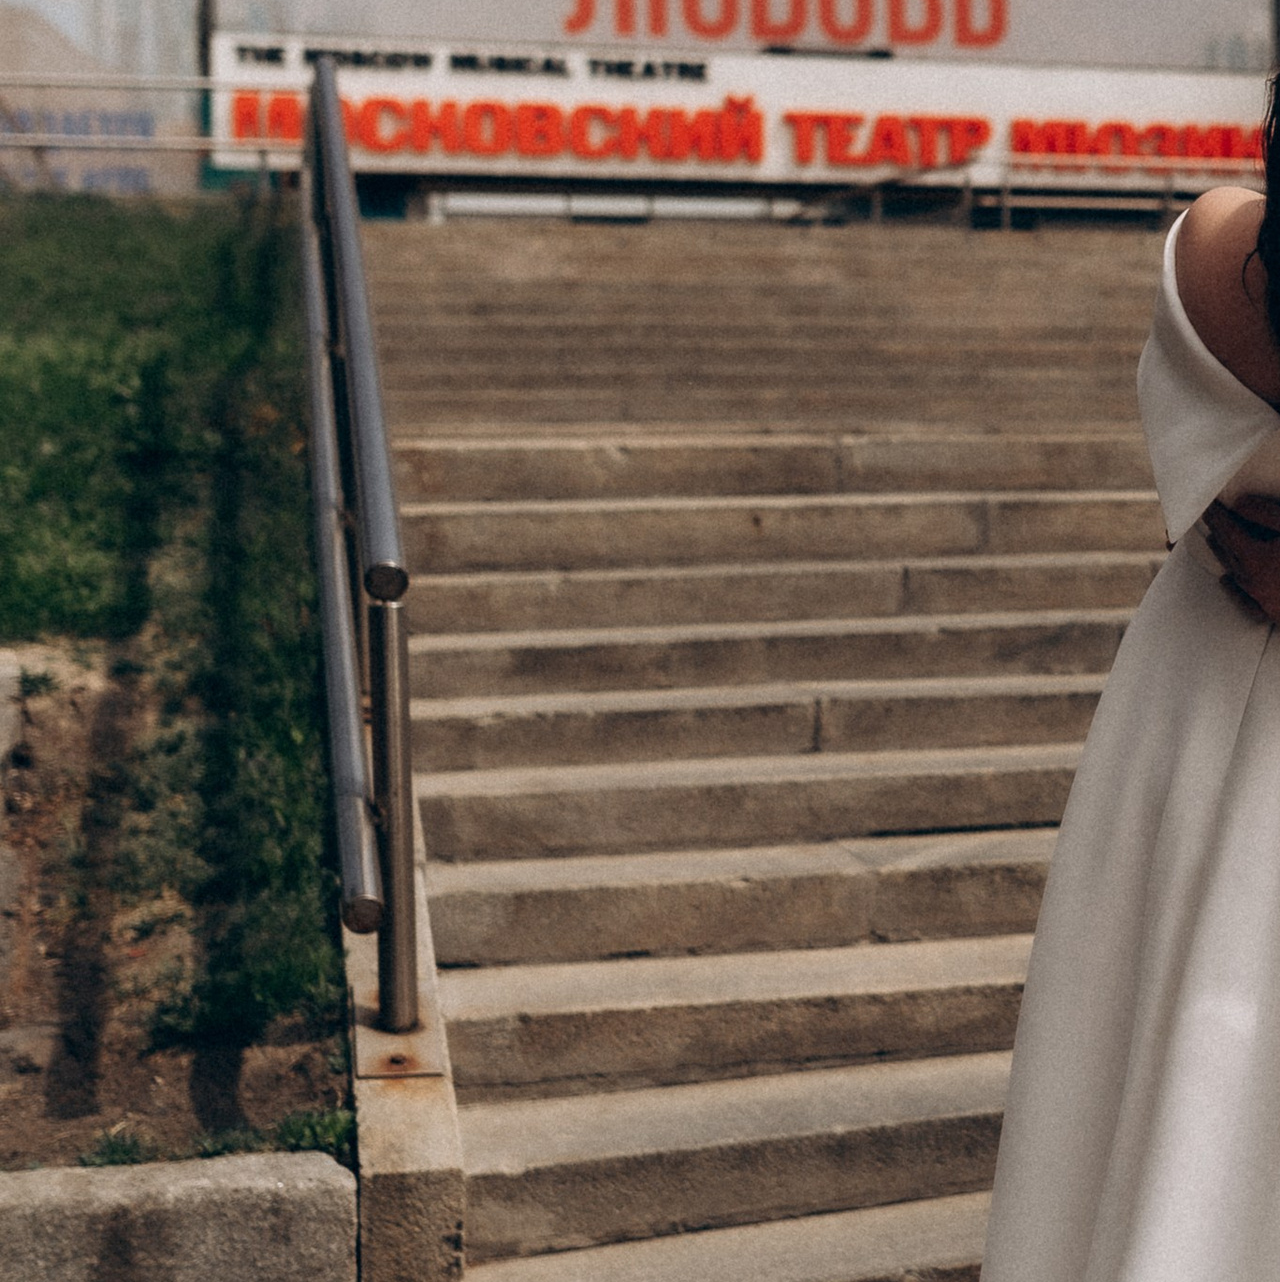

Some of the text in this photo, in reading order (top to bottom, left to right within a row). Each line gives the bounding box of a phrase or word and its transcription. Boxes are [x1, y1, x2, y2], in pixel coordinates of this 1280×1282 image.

[588, 58, 709, 83] THEATRE
[232, 89, 764, 163] МСКОВСКИЙ
[781, 109, 992, 170] ТЕАТР
